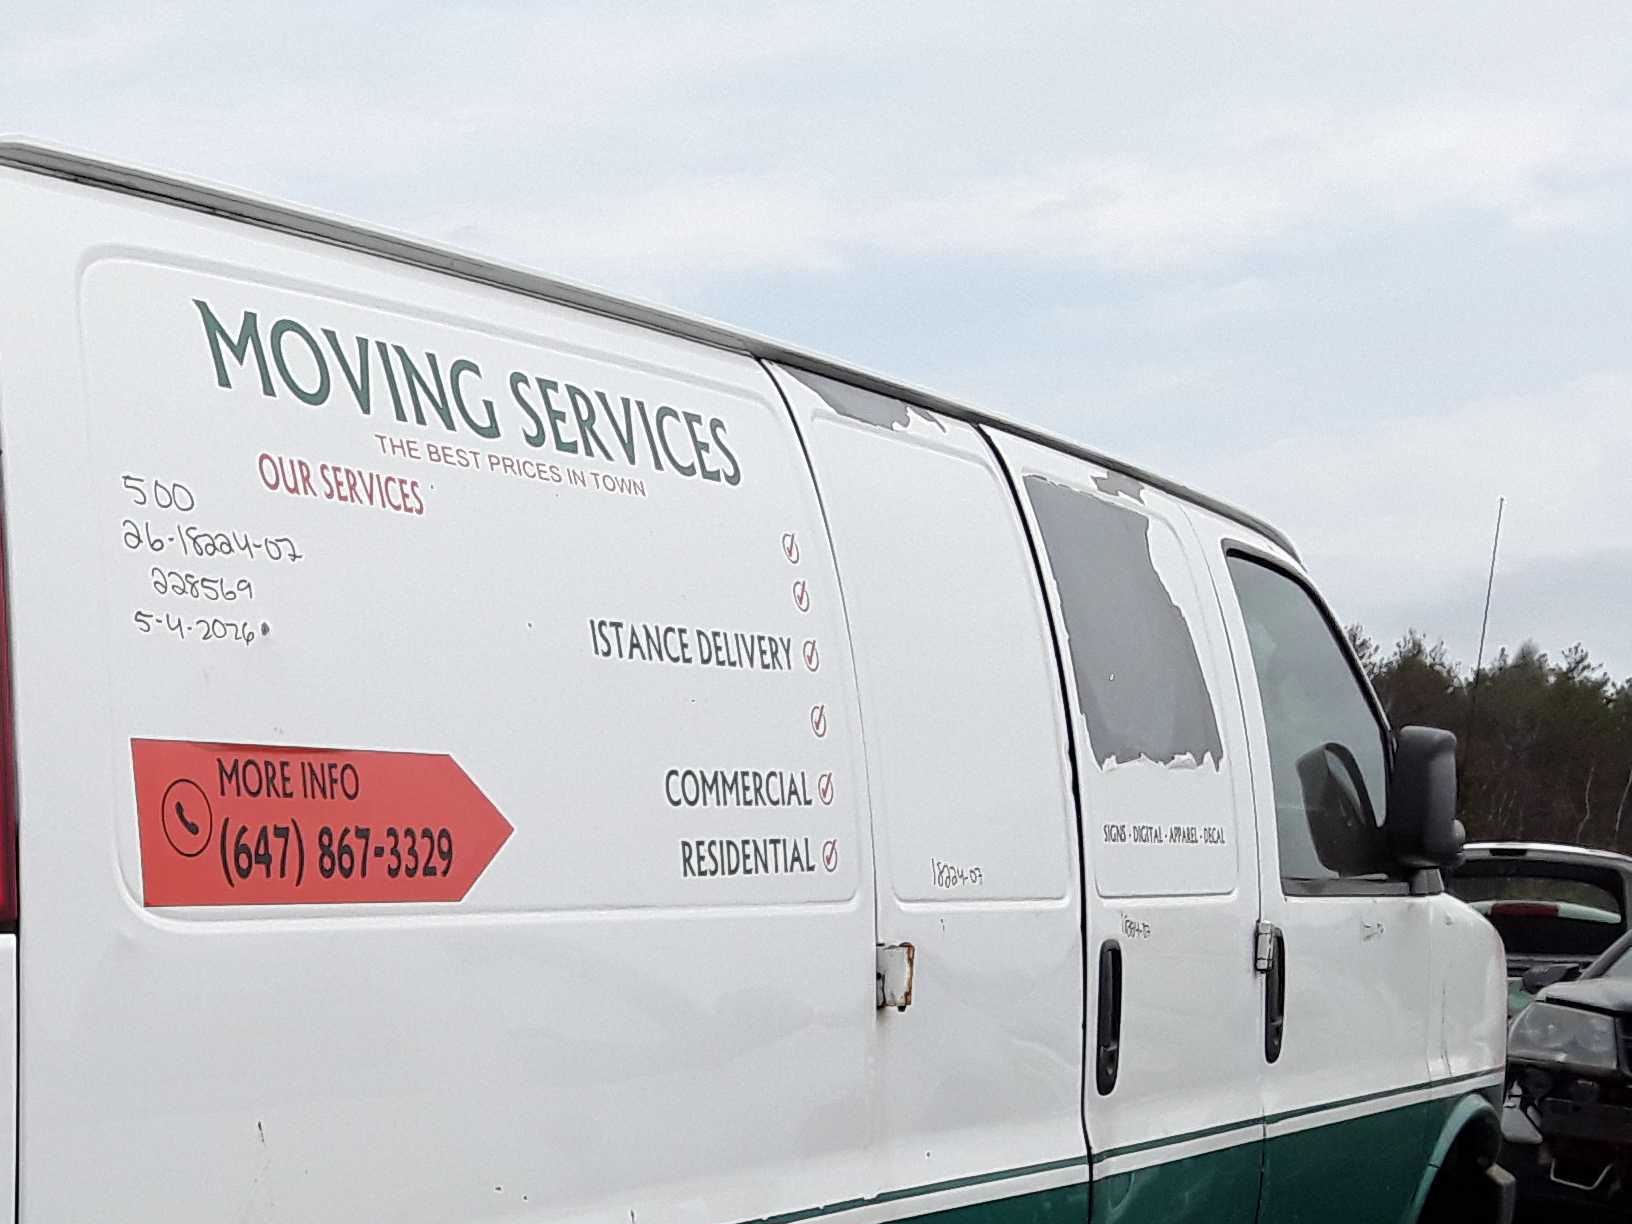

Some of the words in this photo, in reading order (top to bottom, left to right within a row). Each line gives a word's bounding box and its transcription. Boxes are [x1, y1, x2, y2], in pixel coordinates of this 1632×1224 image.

[193, 299, 501, 438] MOVING
[510, 372, 740, 486] SERVICES
[259, 454, 317, 496] OUR
[320, 464, 423, 514] SERVICES
[375, 435, 421, 459] THE
[427, 444, 480, 469] BEST
[488, 455, 562, 482] PRICES
[567, 469, 586, 486] IN
[590, 473, 646, 496] TOWN
[122, 475, 194, 511] 500
[152, 568, 252, 600] 228569
[590, 620, 692, 663] ISTANCE
[696, 630, 791, 669] DELIVERY
[217, 758, 293, 798] MORE
[301, 762, 359, 800] INFO
[666, 770, 812, 806] COMMERCIAL
[220, 819, 305, 888] (647)
[319, 826, 452, 879] 867-3329
[1104, 825, 1126, 842] SIGNS
[1133, 825, 1163, 843] DIGITAL
[1169, 827, 1198, 843] APPAREL
[682, 838, 815, 877] RESIDENTIAL
